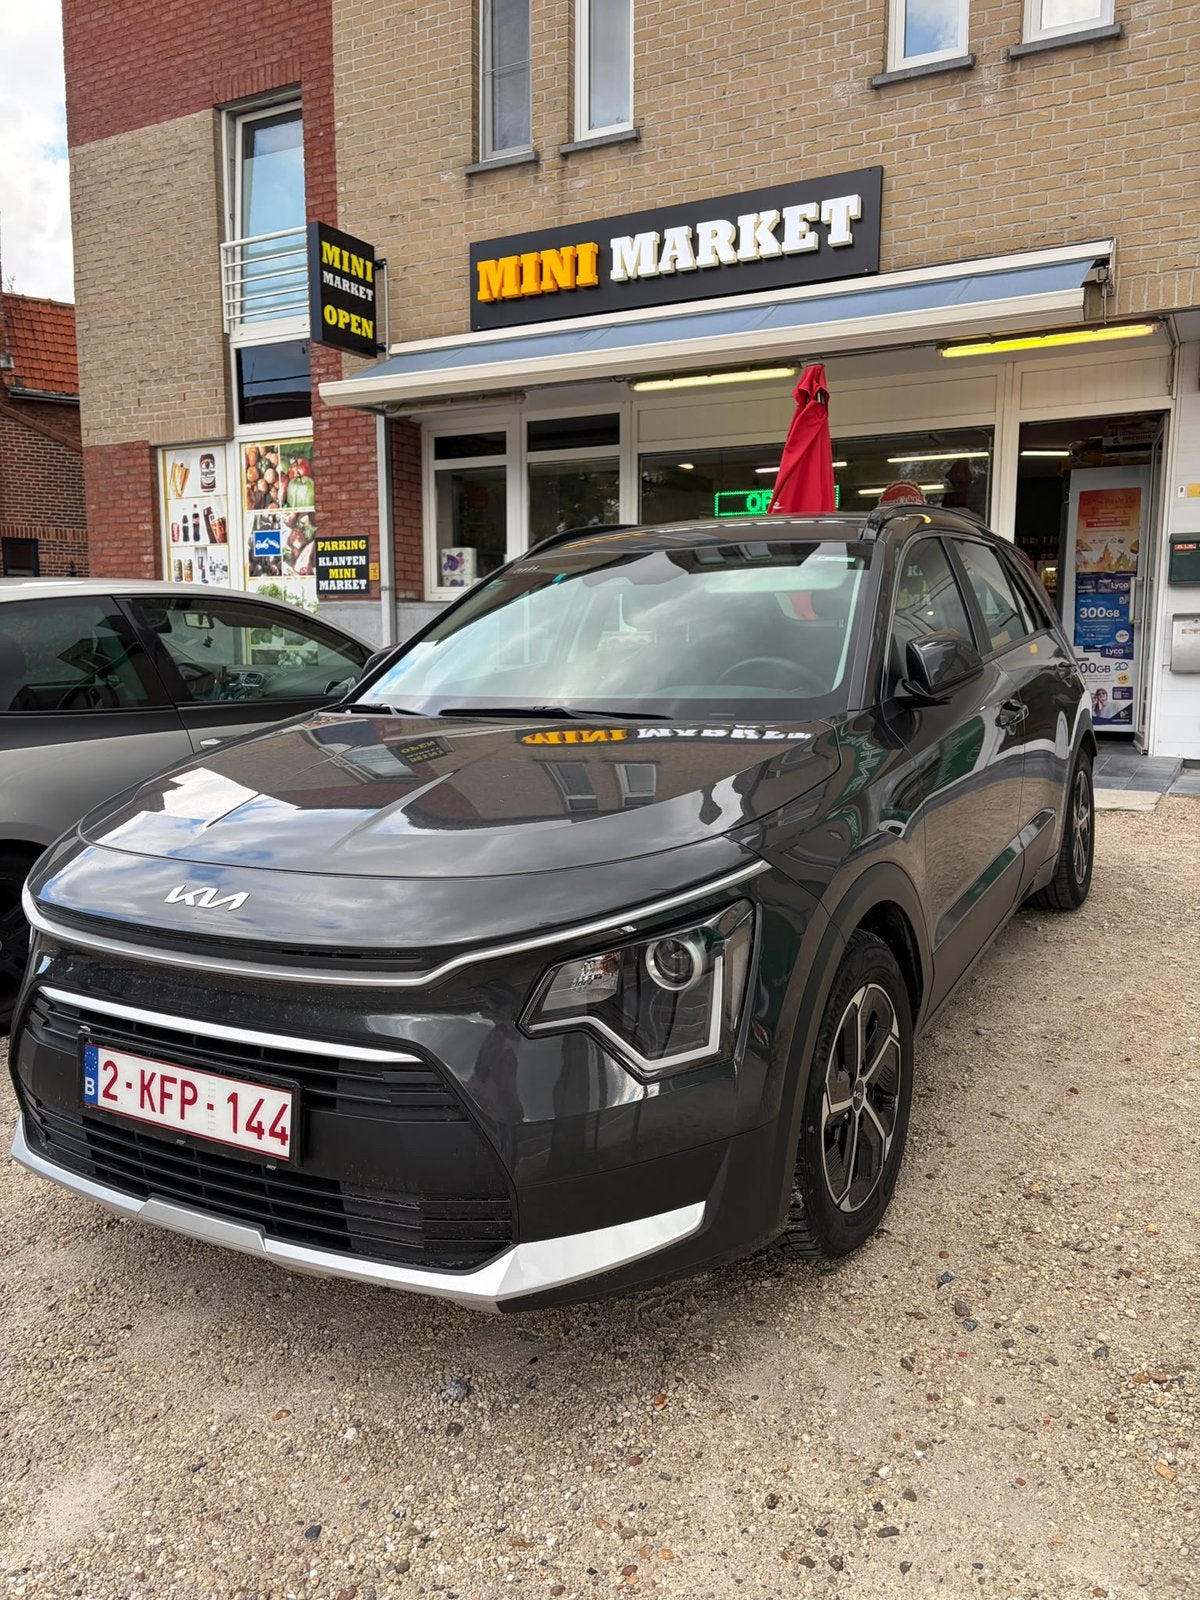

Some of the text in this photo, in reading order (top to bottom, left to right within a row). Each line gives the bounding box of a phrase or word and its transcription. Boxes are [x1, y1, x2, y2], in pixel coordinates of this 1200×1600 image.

[477, 194, 862, 302] MINI MARKET
[321, 240, 373, 283] MINI
[322, 270, 373, 301] MARKET
[323, 304, 373, 339] OPEN
[317, 540, 366, 551] PARKING
[318, 556, 366, 566] KLANTEN
[329, 568, 356, 579] MINI
[319, 579, 367, 590] MARKET
[1111, 582, 1129, 590] Lyca
[1080, 607, 1120, 618] 300GB
[1105, 648, 1124, 656] Lyca
[1079, 663, 1111, 674] 00GB
[164, 884, 250, 912] KIA
[84, 1060, 289, 1146] B 2-KFP-144
